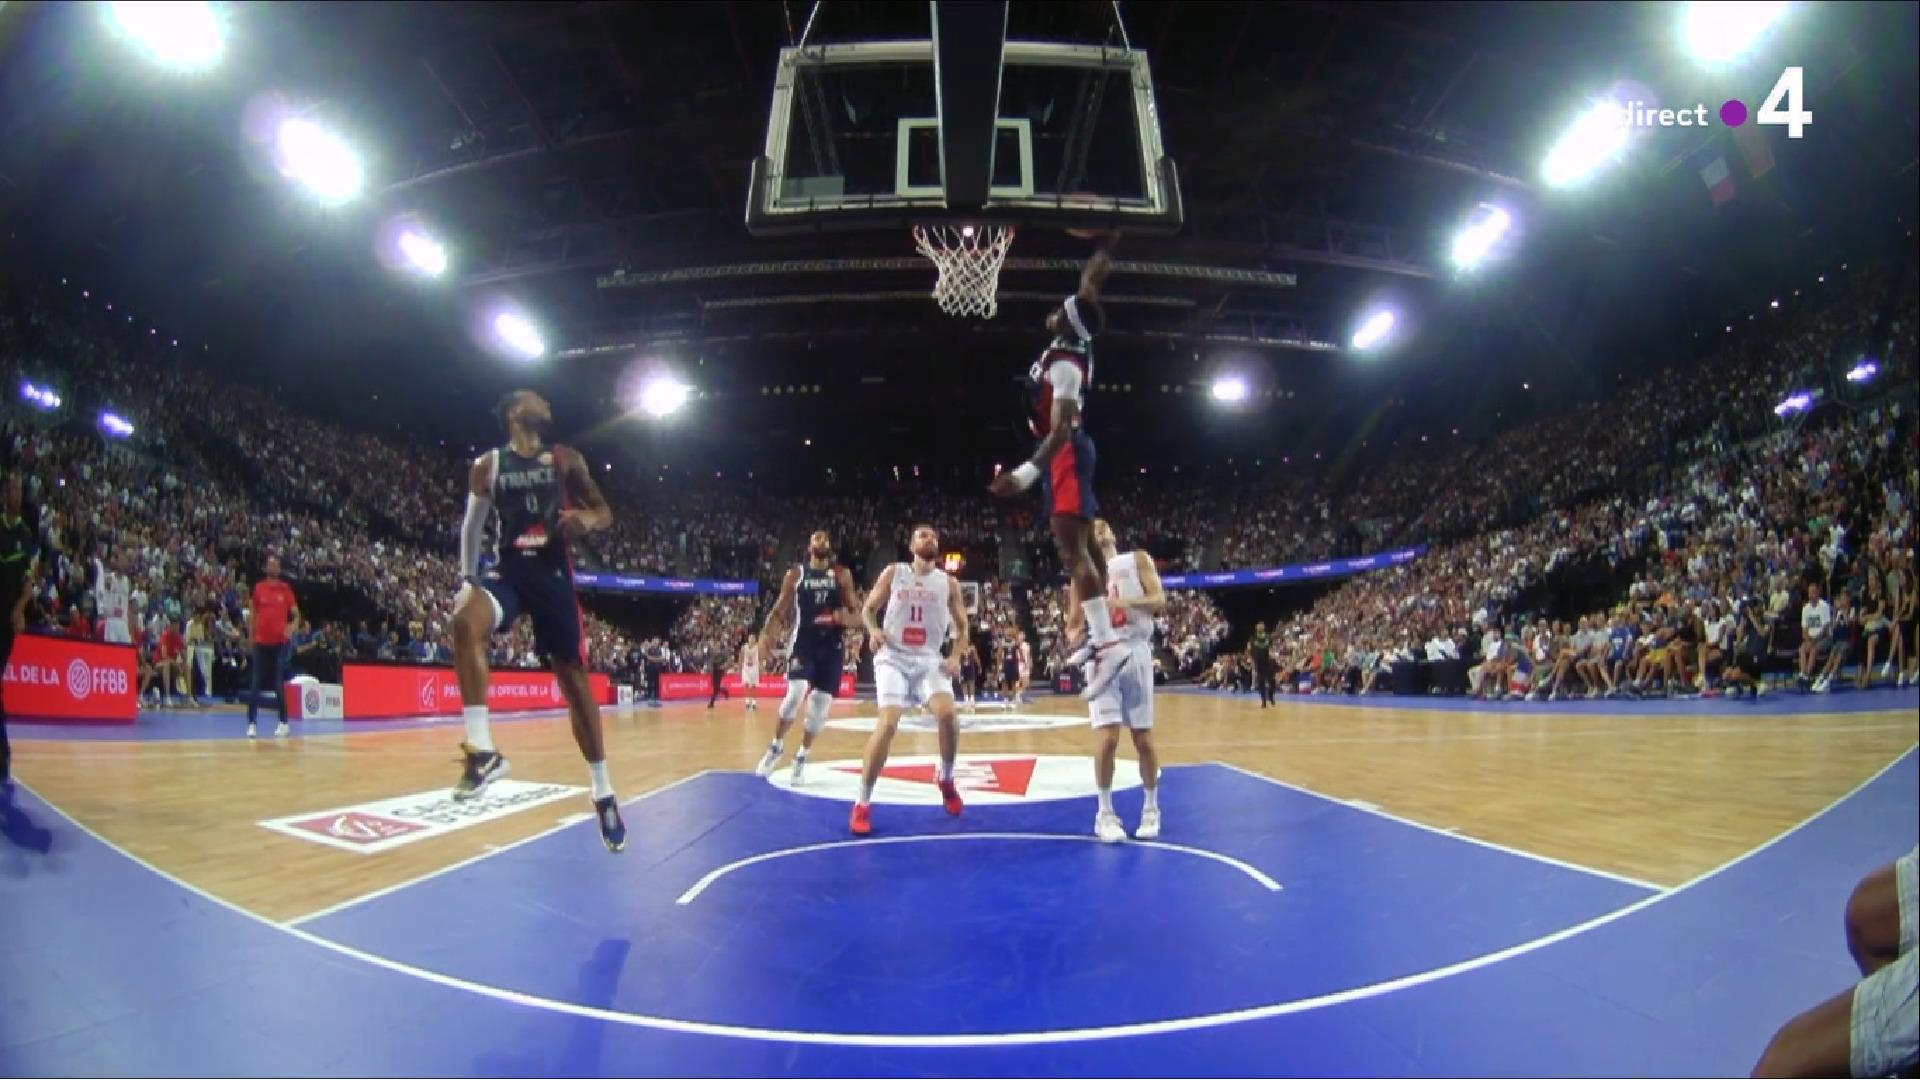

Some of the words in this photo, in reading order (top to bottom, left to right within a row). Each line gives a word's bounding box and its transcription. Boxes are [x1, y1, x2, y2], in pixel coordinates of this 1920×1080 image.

[911, 605, 922, 622] 11
[20, 665, 39, 684] DE
[41, 666, 60, 685] LA
[92, 666, 129, 695] FFBB
